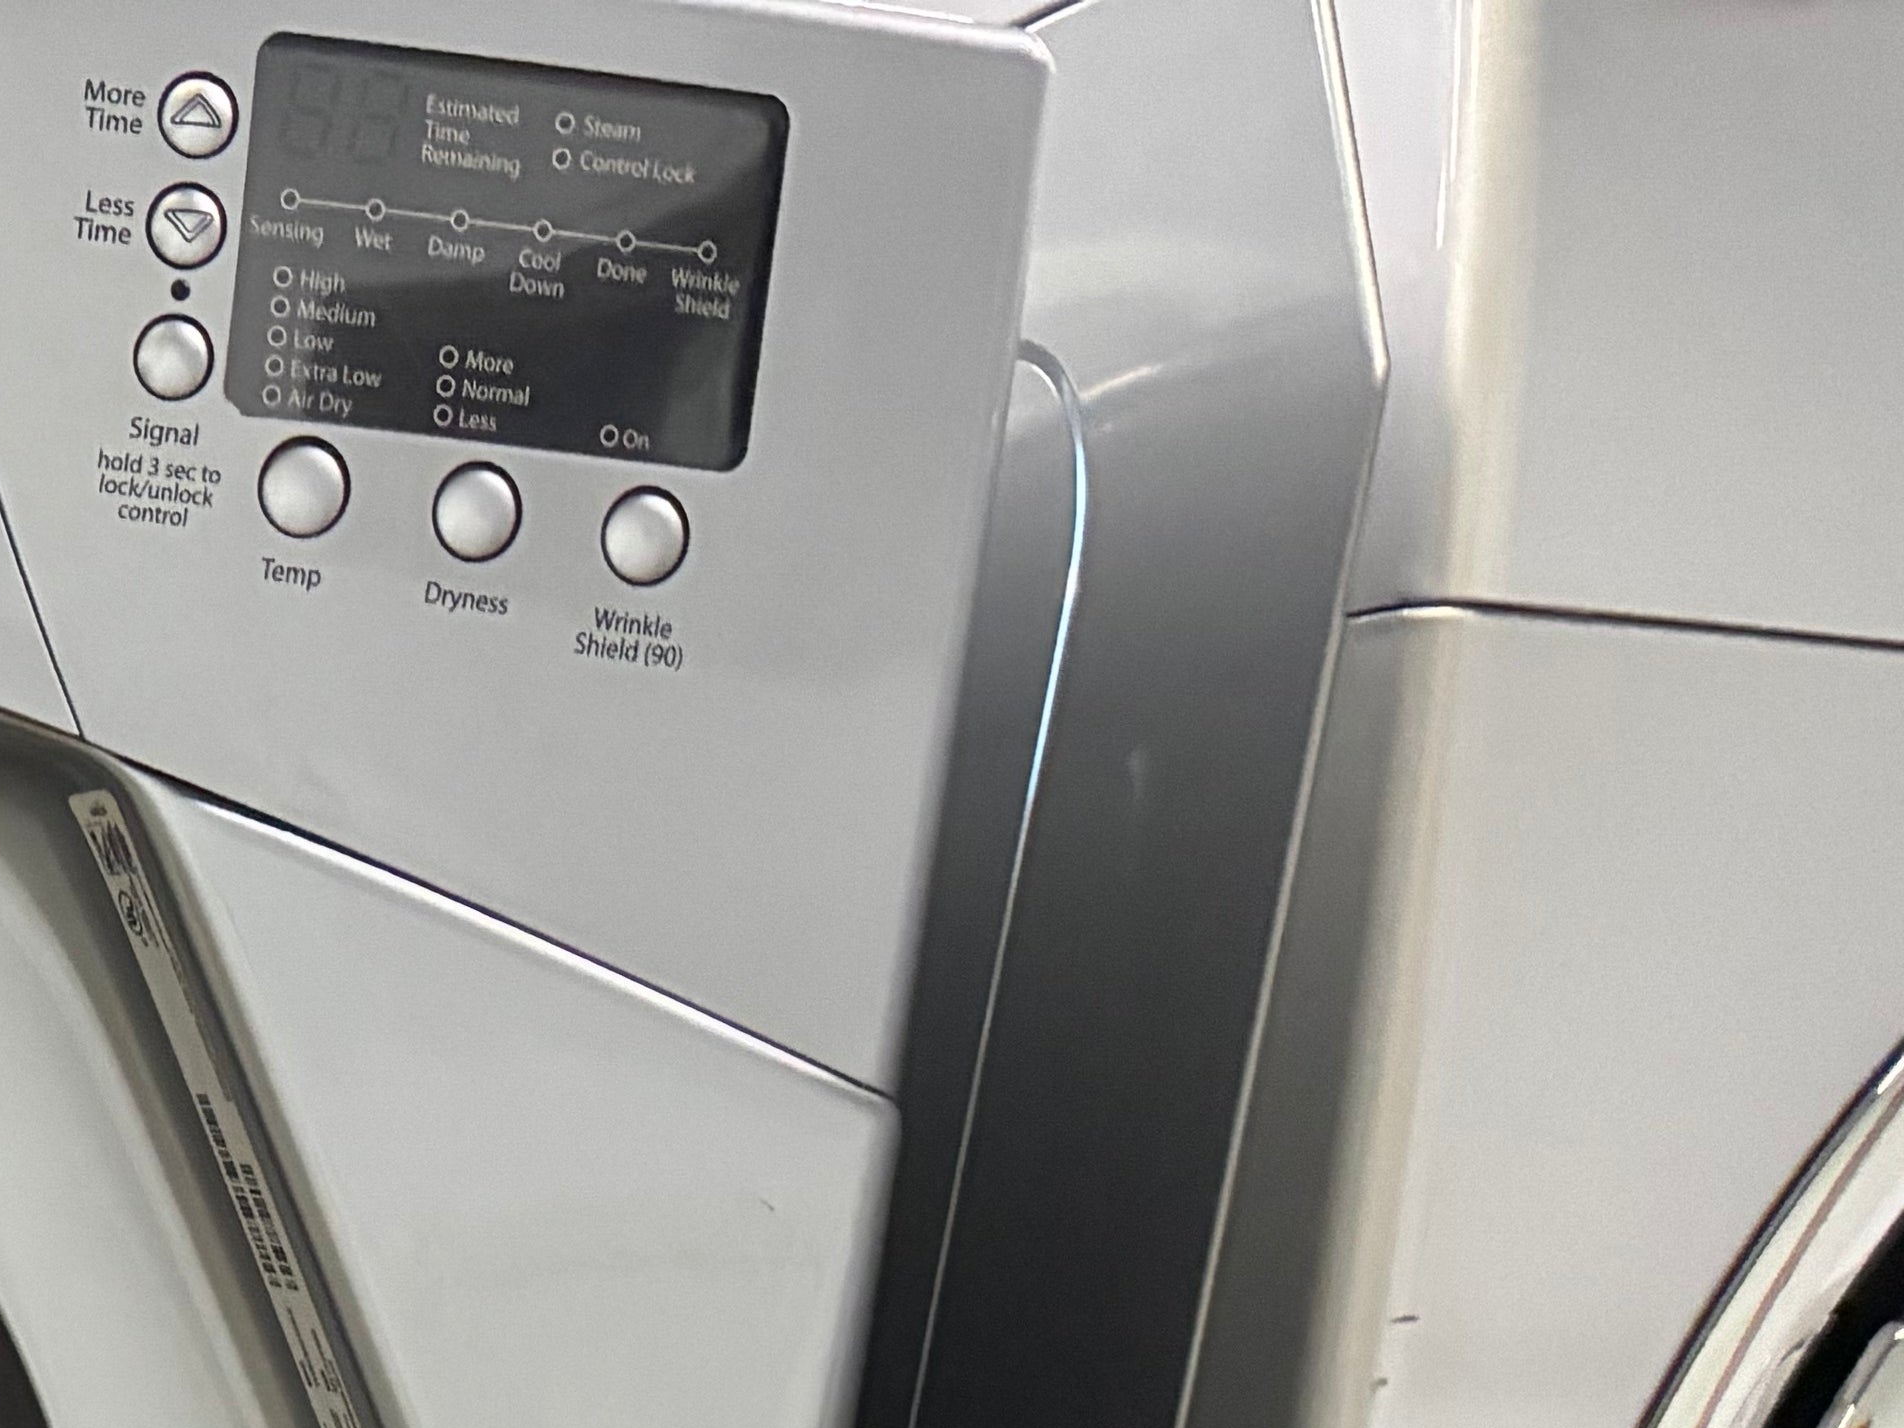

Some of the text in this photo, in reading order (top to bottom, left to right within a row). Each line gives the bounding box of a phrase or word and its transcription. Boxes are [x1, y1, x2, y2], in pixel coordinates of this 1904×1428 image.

[84, 79, 146, 106] More
[85, 106, 143, 135] Time
[426, 94, 520, 125] Estimated
[426, 120, 470, 144] Time
[584, 115, 641, 141] Steam
[421, 144, 520, 179] Remaining
[580, 151, 695, 185] Control Lock
[85, 190, 134, 217] Less
[74, 216, 132, 244] Time
[250, 214, 324, 247] Sensing
[355, 226, 393, 252] Wet
[427, 235, 486, 264] Damp
[519, 249, 561, 271] Cool
[299, 269, 346, 295] High
[597, 257, 647, 283] Done
[672, 268, 741, 295] Wrinkle
[509, 271, 565, 299] Down
[297, 301, 376, 328] Medium
[675, 294, 731, 320] Shield
[294, 332, 334, 352] Low
[291, 360, 382, 388] Extra Low
[464, 349, 515, 375] More
[287, 389, 353, 418] Air Dry
[462, 378, 530, 406] Normal
[128, 416, 200, 448] Signal
[458, 409, 497, 431] Less
[622, 428, 650, 450] On
[97, 448, 222, 485] hold 3 sec to
[98, 473, 214, 509] lock/unlock
[117, 504, 189, 528] control
[261, 556, 322, 593] Temp
[424, 581, 509, 616] Dryness
[593, 607, 673, 640] Wrinkle
[574, 632, 684, 671] Shield (90)
